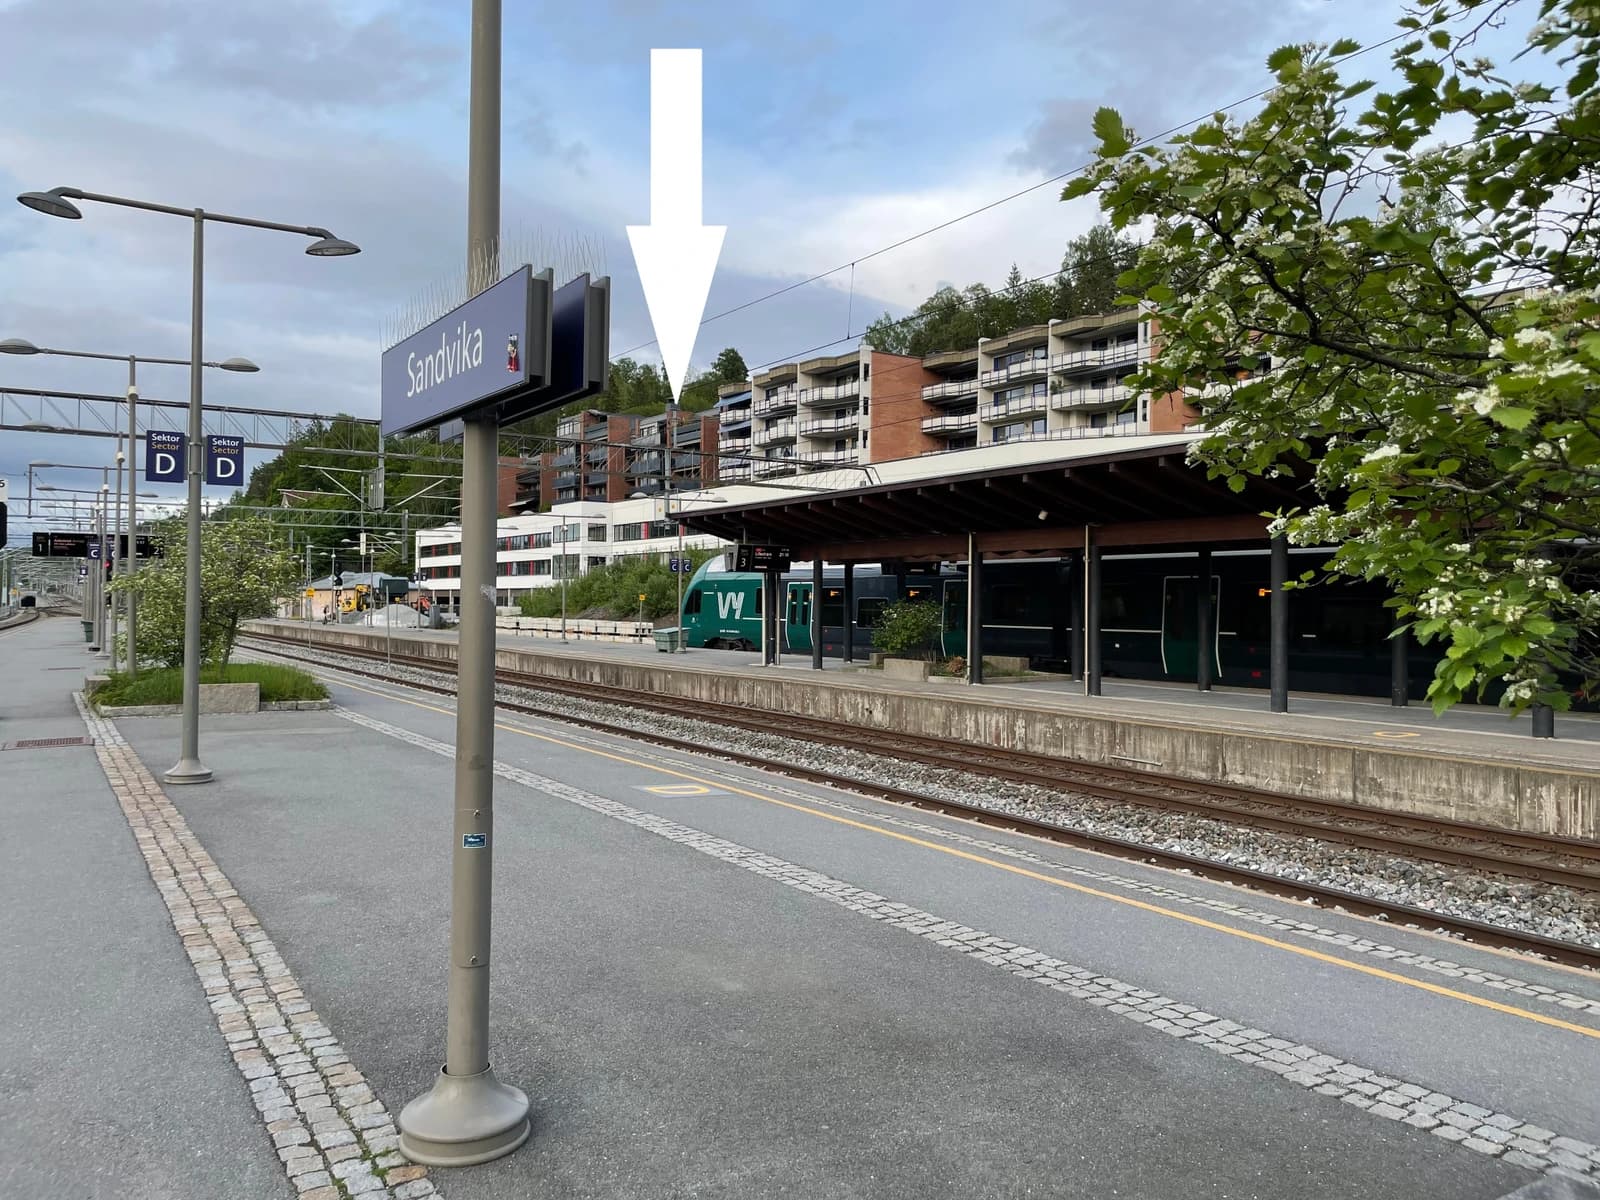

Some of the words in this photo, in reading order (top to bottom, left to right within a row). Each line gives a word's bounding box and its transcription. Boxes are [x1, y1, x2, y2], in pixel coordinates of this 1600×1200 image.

[407, 320, 483, 398] Sandvika
[151, 433, 180, 442] Sektor
[212, 437, 240, 447] Sektor
[151, 442, 180, 451] Sector
[212, 446, 239, 455] Sector
[155, 453, 176, 475] D
[216, 457, 236, 478] D
[90, 549, 98, 558] C
[740, 557, 746, 567] 3
[671, 563, 678, 571] C
[684, 564, 691, 572] C
